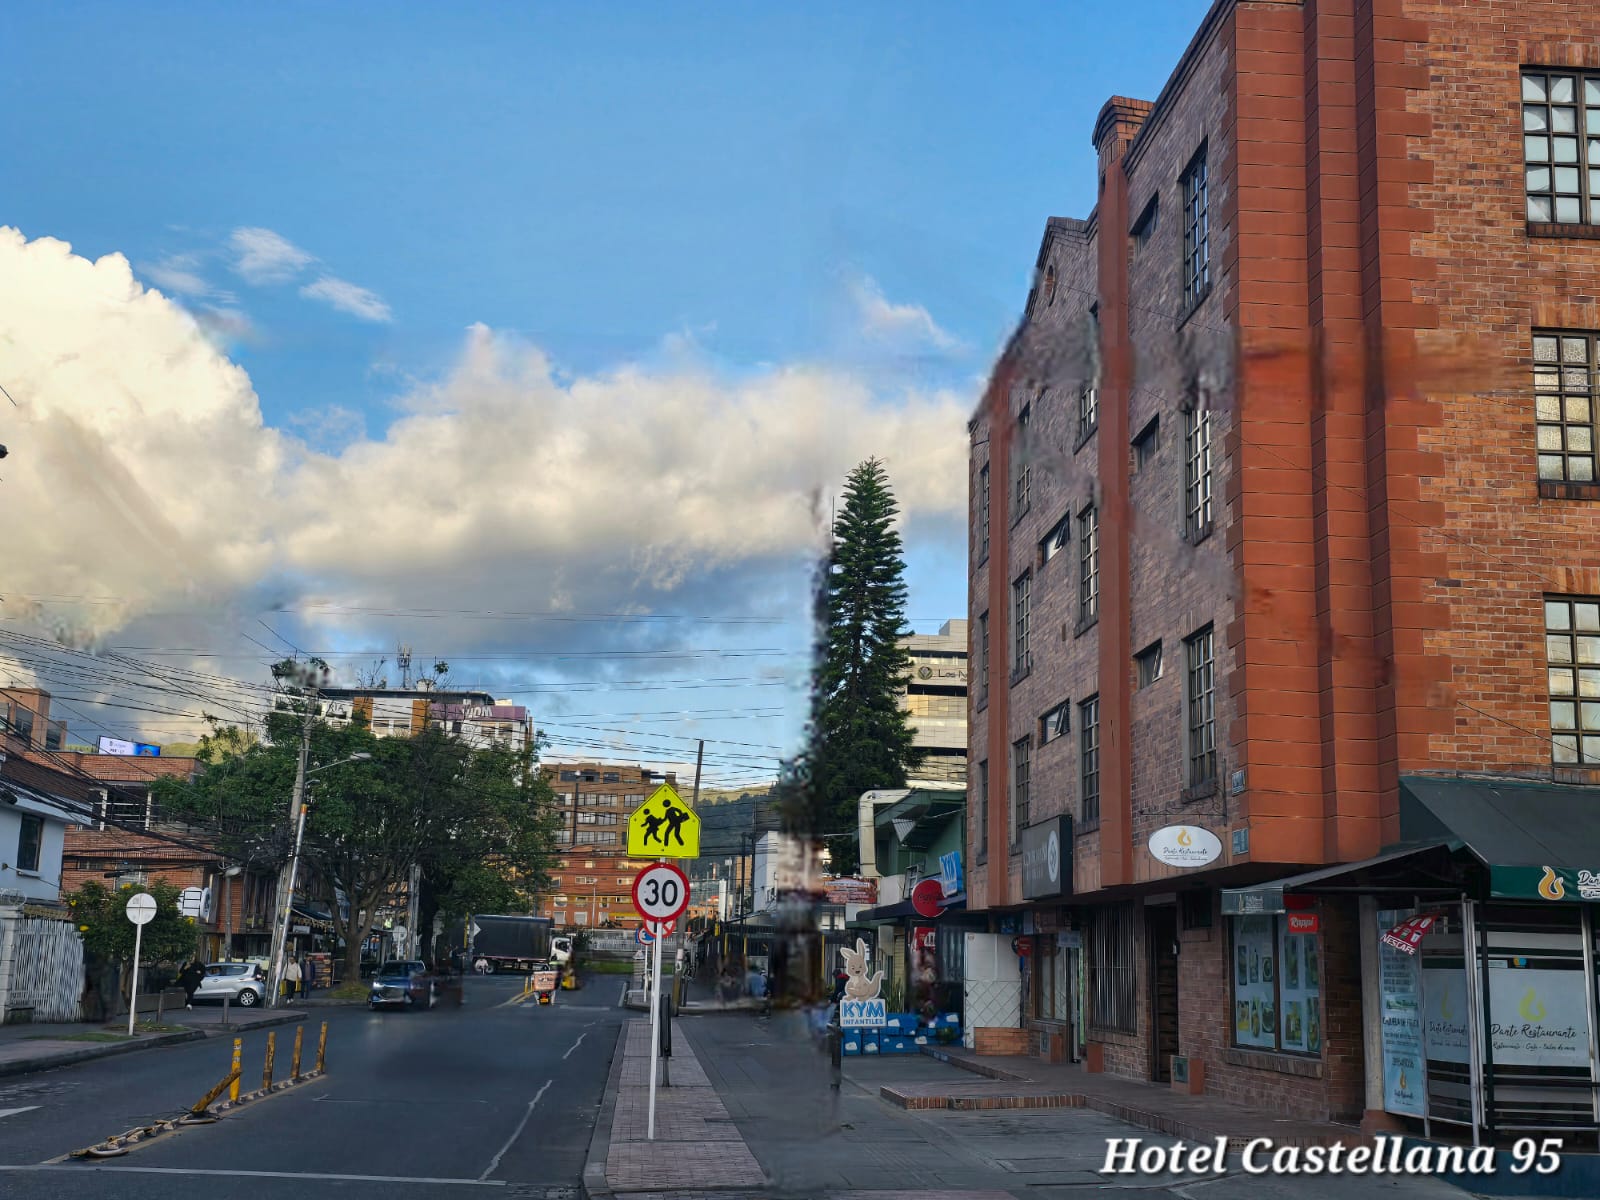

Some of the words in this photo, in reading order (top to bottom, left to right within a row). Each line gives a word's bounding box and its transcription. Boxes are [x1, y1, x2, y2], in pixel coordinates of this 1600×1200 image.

[644, 878, 678, 907] 30
[1290, 916, 1314, 929] Rappi
[842, 1001, 884, 1018] KYM
[1491, 1023, 1518, 1037] Dante
[1520, 1023, 1577, 1039] Restaurante
